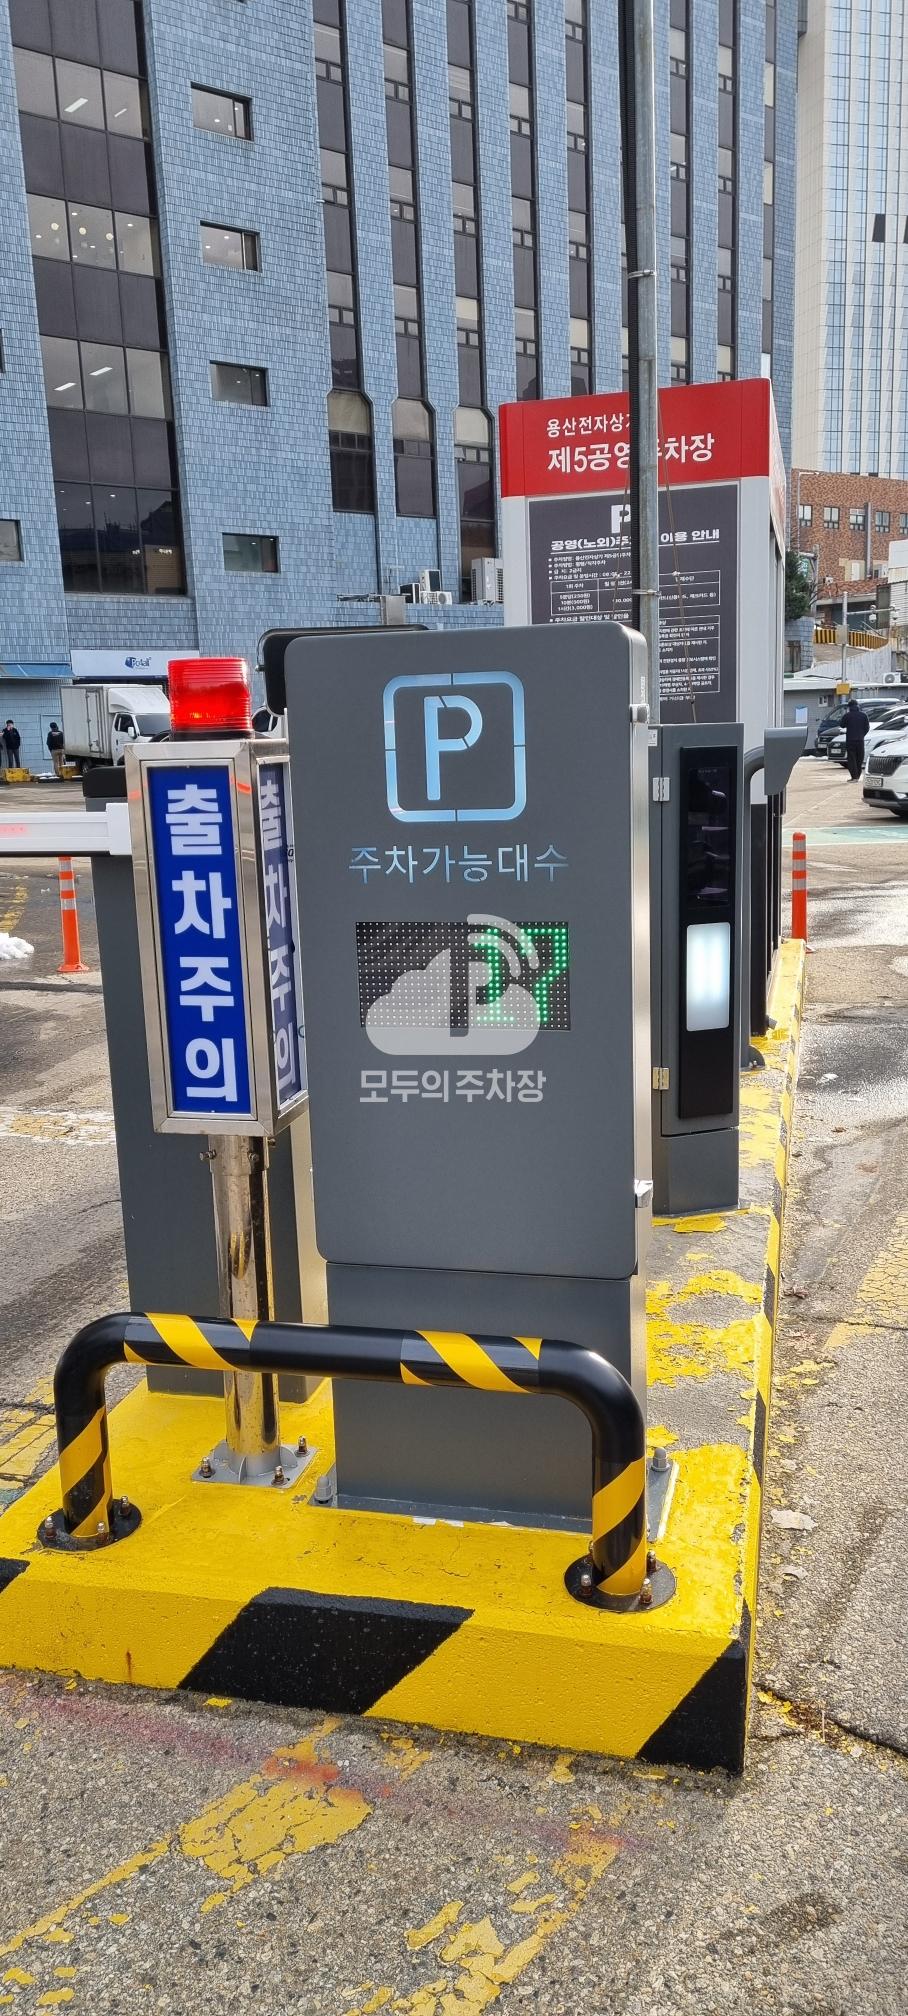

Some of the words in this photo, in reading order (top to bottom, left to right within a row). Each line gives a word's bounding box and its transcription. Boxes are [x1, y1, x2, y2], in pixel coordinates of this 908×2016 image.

[547, 413, 630, 438] 용산전자상
[547, 433, 715, 473] 제5공영차장
[551, 536, 631, 551] 공영(노외)주
[660, 531, 688, 543] 이용
[691, 529, 720, 541] 안내
[424, 695, 483, 800] P
[349, 843, 569, 884] 주차가능대수
[165, 784, 238, 1102] 출차주의
[259, 778, 298, 1095] 출차주의
